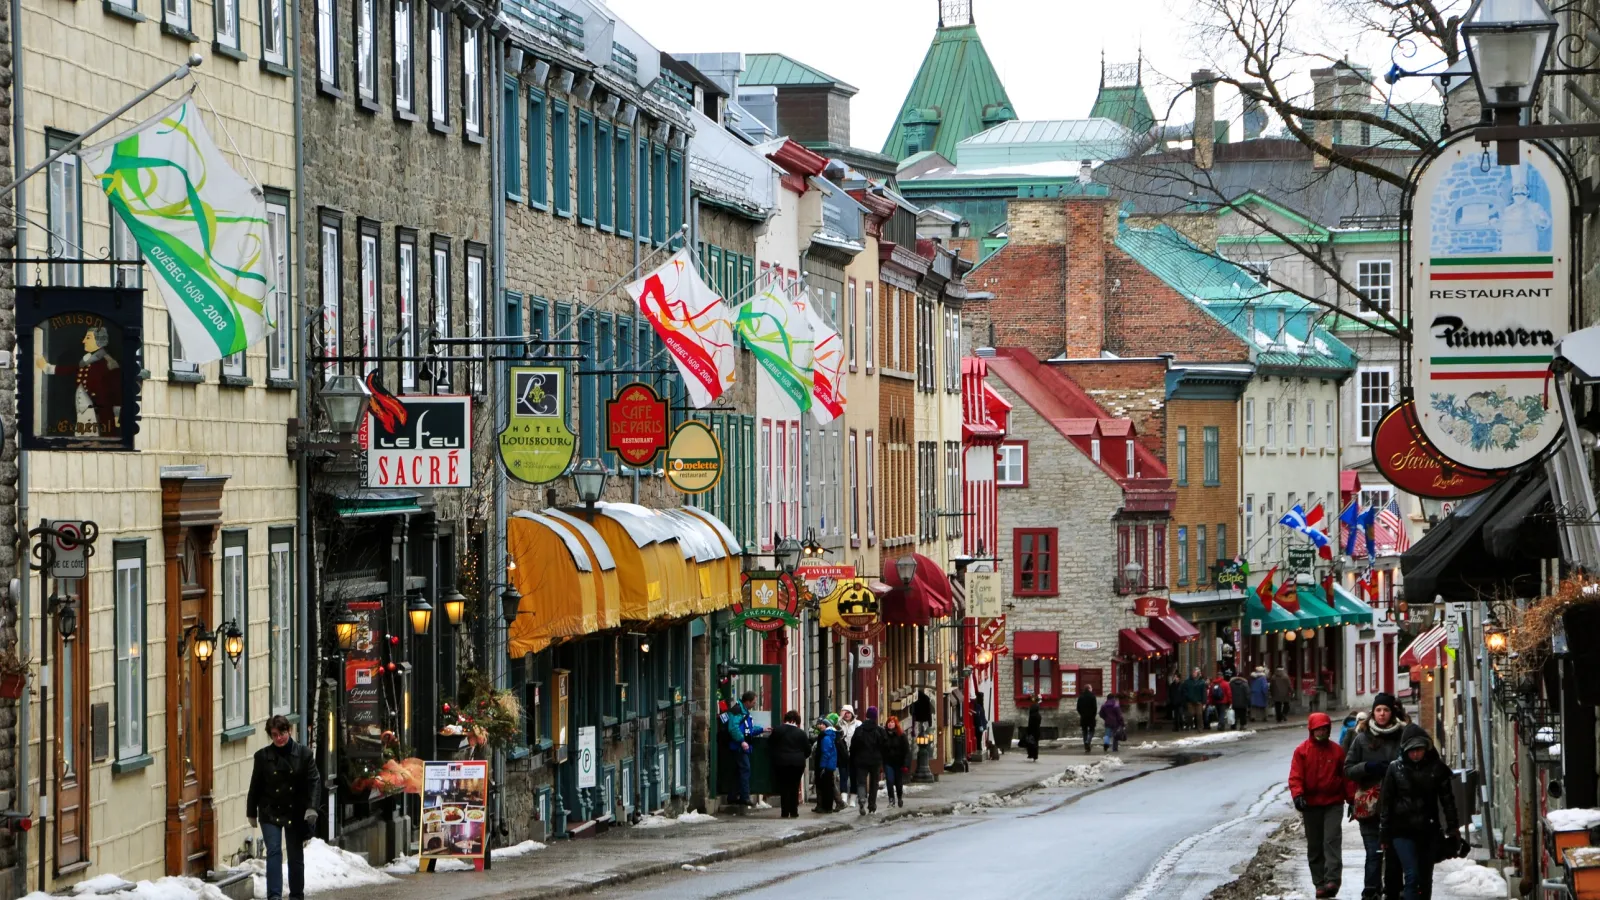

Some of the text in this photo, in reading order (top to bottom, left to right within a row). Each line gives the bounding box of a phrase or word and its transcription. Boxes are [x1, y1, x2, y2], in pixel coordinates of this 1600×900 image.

[150, 246, 186, 283] QUÉBEC
[1430, 288, 1553, 299] RESTAURANT
[666, 337, 688, 358] QUÉBEC
[513, 425, 560, 433] HÔTEL
[612, 420, 663, 434] DE PARIS
[360, 416, 368, 488] RESTAURAN
[379, 450, 460, 485] SACRÉ
[744, 609, 785, 617] CRÉMAZIE
